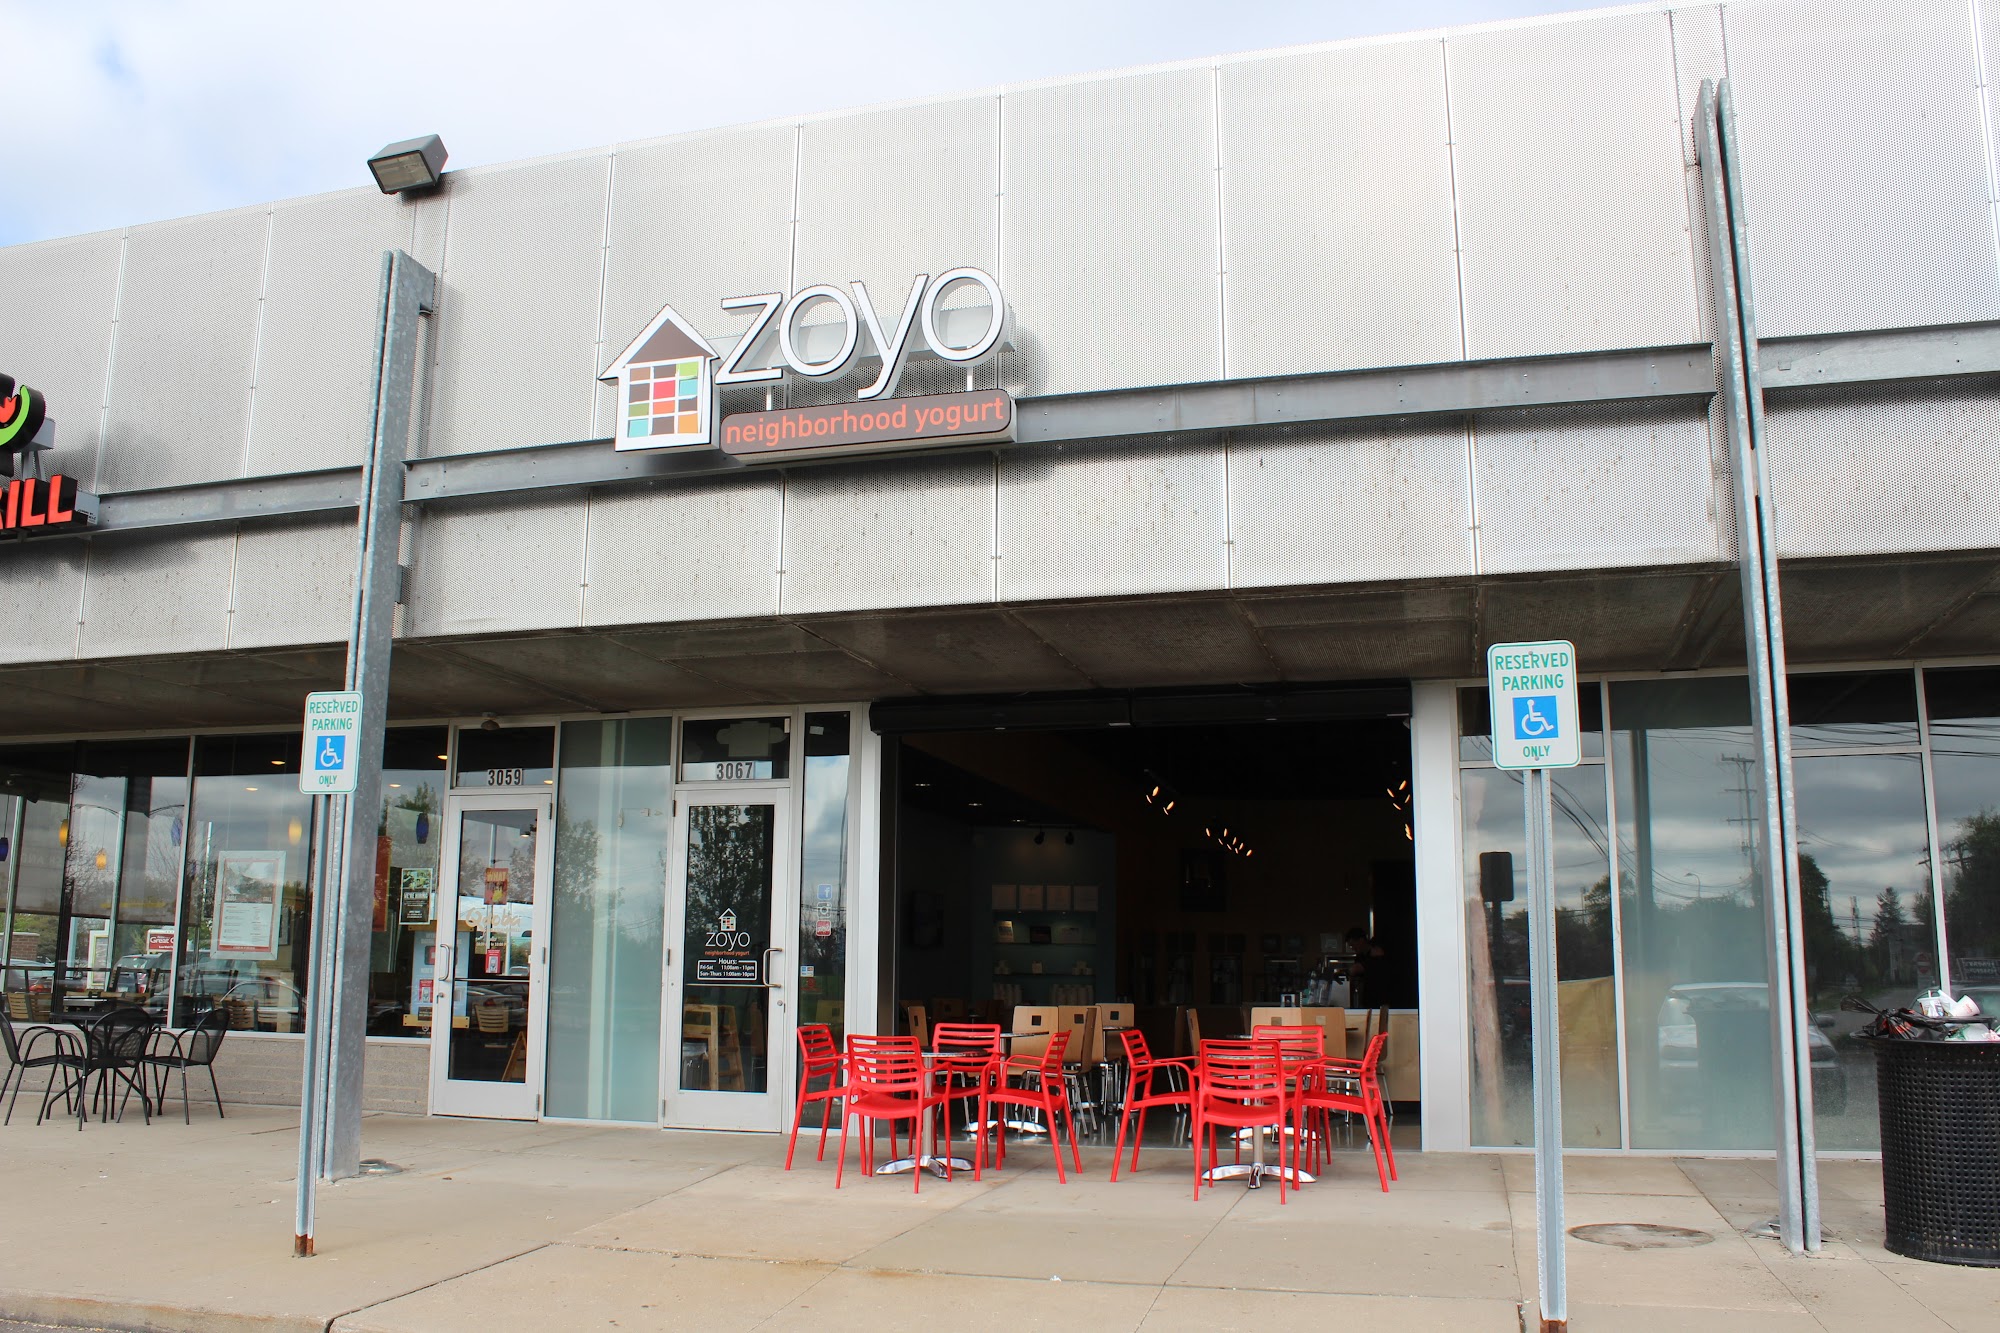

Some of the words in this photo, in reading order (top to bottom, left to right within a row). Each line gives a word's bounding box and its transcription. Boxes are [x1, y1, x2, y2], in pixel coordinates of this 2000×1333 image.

[715, 266, 1005, 400] zoyo
[726, 404, 907, 447] neighborhood
[913, 397, 1004, 435] yogurt
[1495, 652, 1568, 670] RESERVED
[1502, 673, 1564, 691] PARKING
[308, 700, 358, 715] RESERVED
[311, 717, 353, 731] PARKING
[1523, 745, 1550, 758] ONLY
[318, 775, 338, 786] ONLY
[487, 769, 522, 787] 3059
[716, 762, 753, 781] 3067
[705, 931, 750, 951] zoyo
